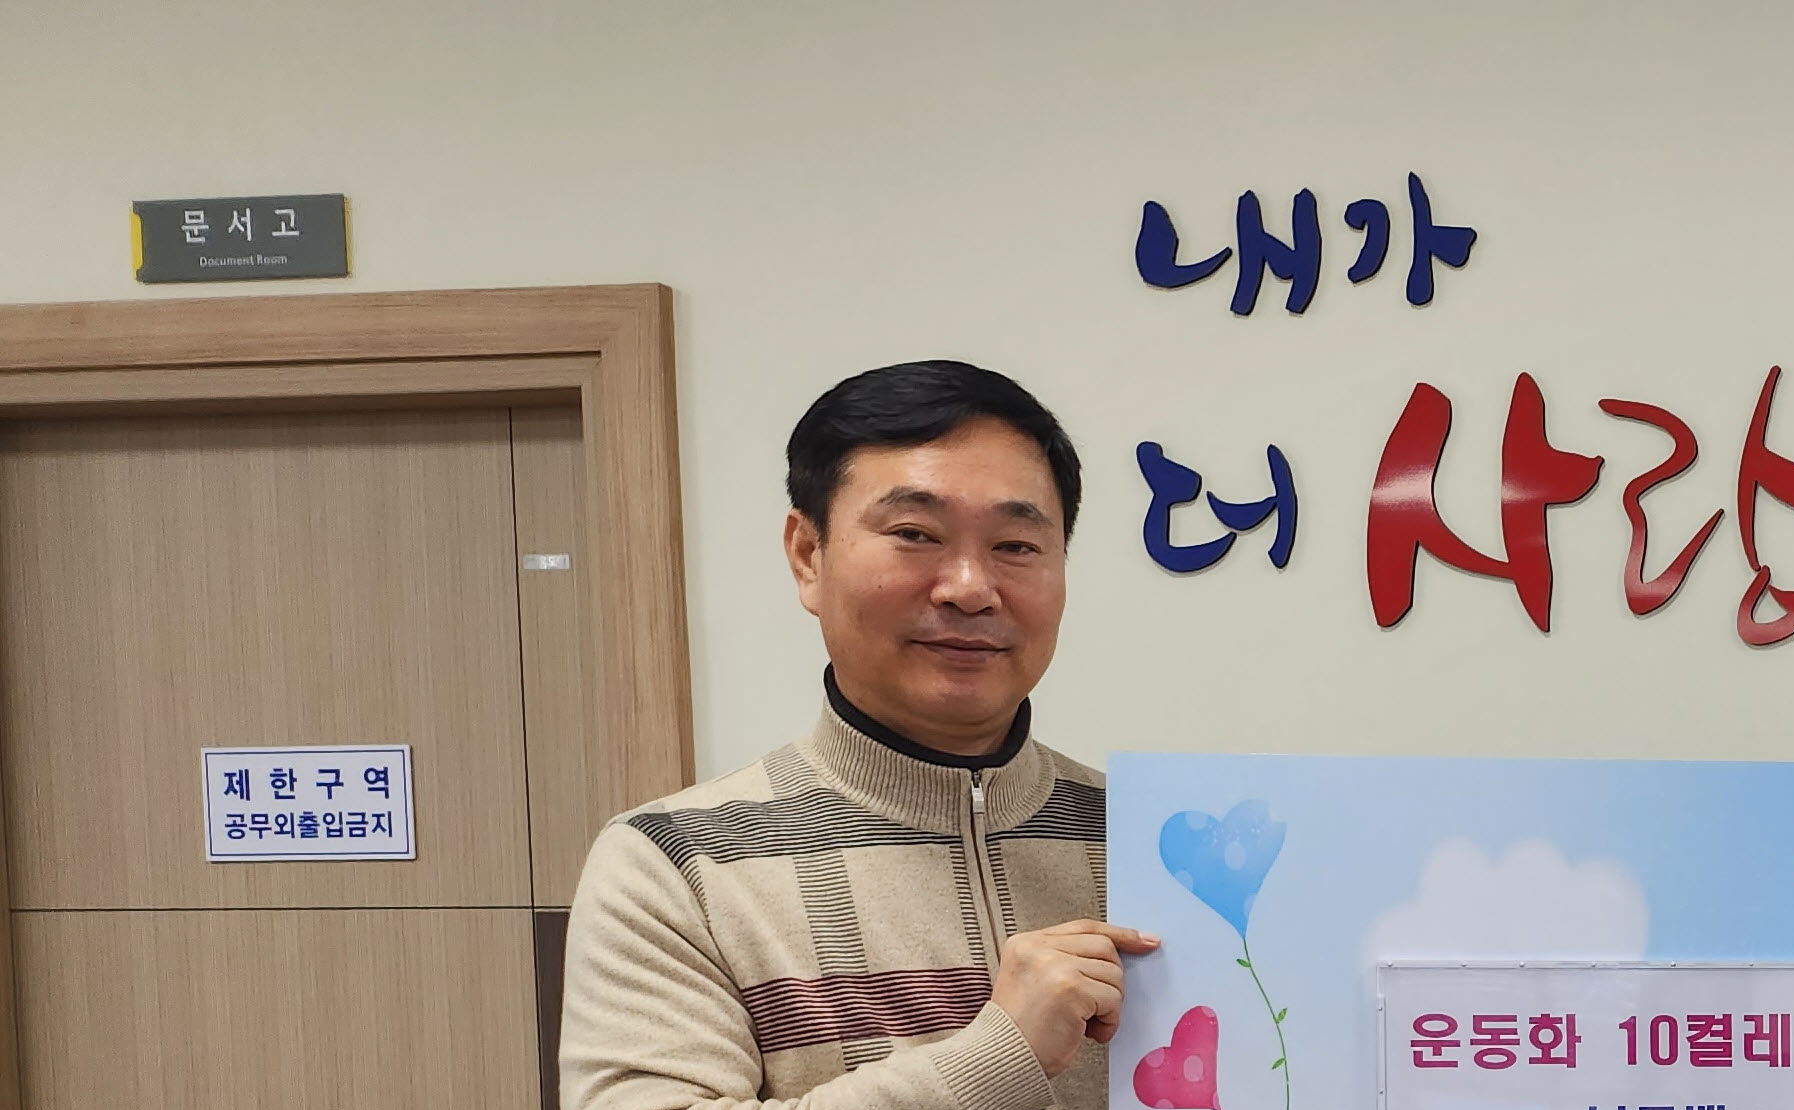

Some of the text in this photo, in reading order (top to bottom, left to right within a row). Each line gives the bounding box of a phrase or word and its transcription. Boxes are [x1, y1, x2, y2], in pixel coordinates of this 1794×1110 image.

[199, 254, 288, 267] Document Room
[1135, 172, 1477, 315] 내가
[1137, 441, 1297, 572] 더
[1409, 1012, 1582, 1070] 운동화
[1618, 1012, 1792, 1069] 10켤레
